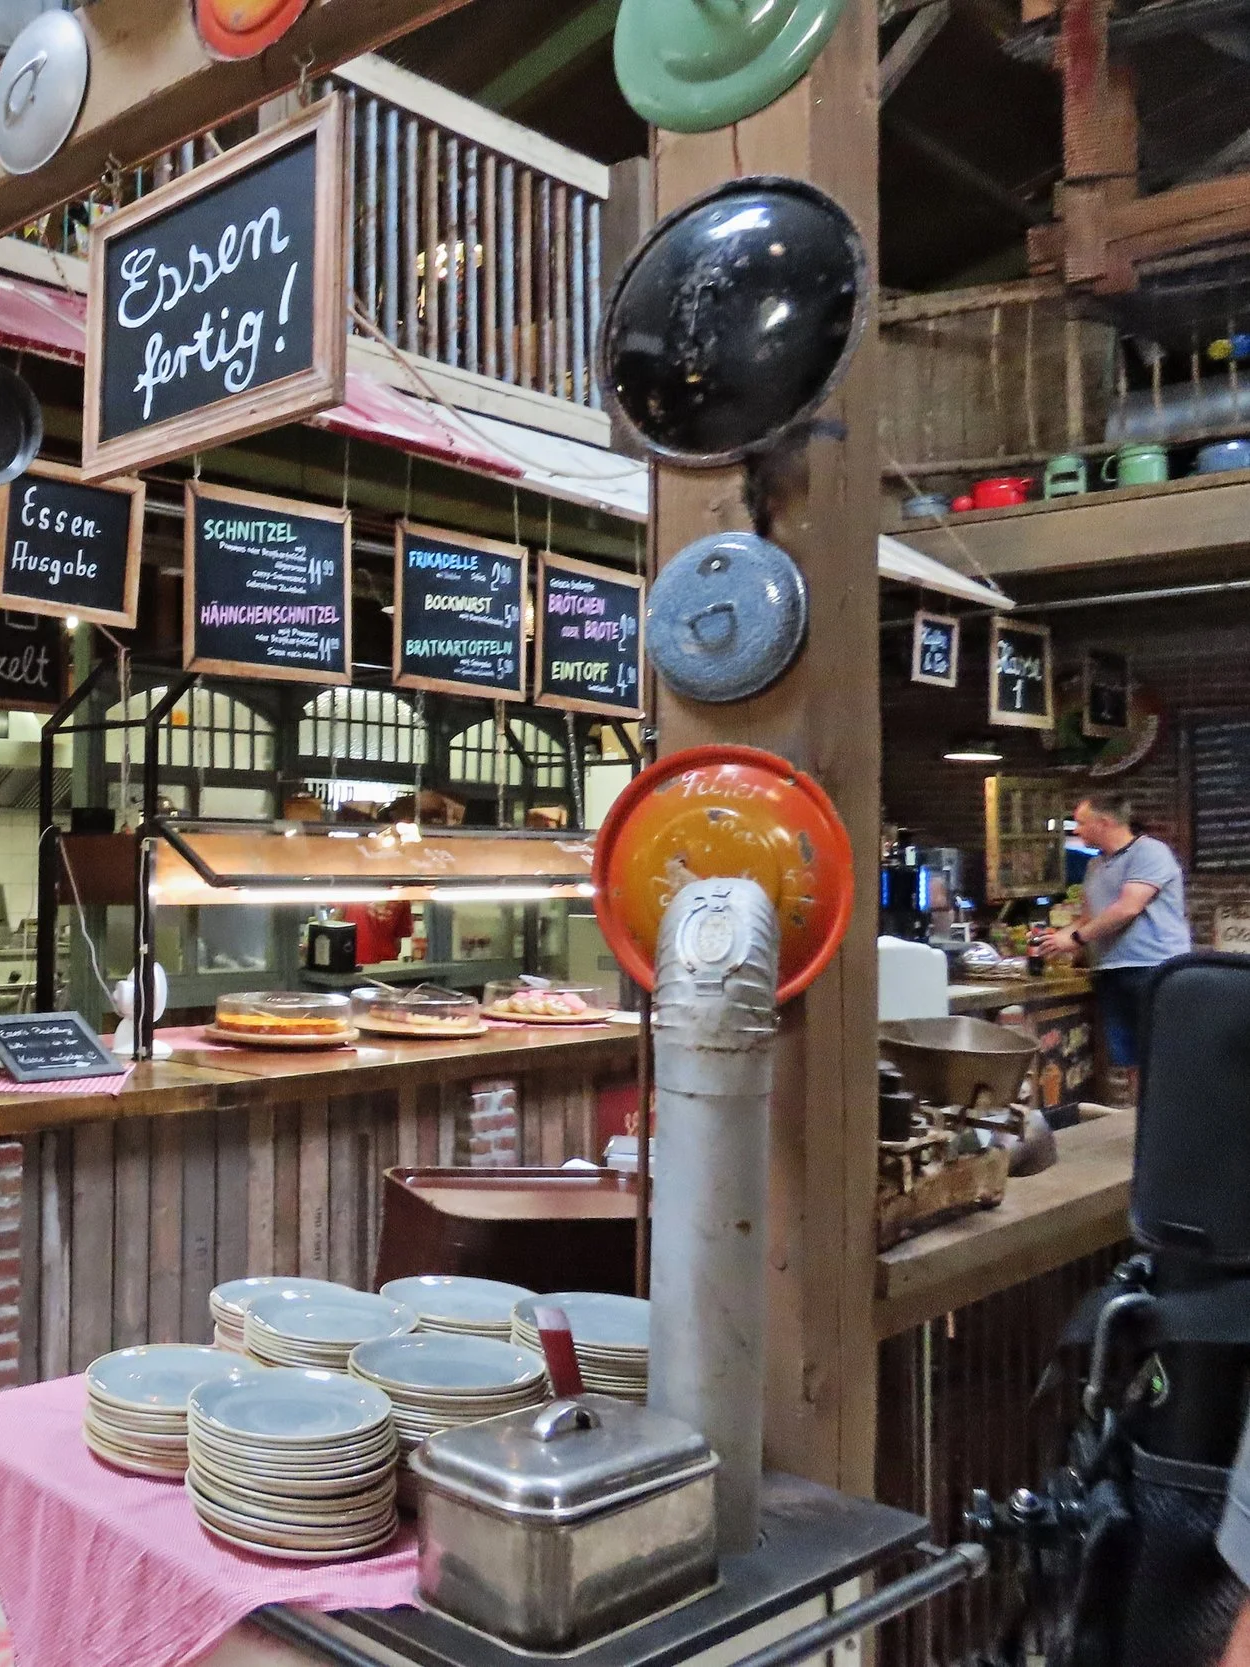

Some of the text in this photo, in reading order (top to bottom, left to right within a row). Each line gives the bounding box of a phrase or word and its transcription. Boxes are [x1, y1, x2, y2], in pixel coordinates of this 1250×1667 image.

[118, 206, 290, 328] Essen
[203, 518, 298, 543] SCHNITZEL
[11, 540, 98, 585] Ausgabe
[408, 550, 479, 571] FRIKADELLE
[200, 600, 339, 628] HÄHNCHENSCHNITZEL
[424, 593, 493, 614] BOCKWURST
[548, 592, 605, 616] BRÖTCHEN
[406, 639, 512, 657] BRATKARTOFFELN
[551, 660, 610, 682] EINTOPF
